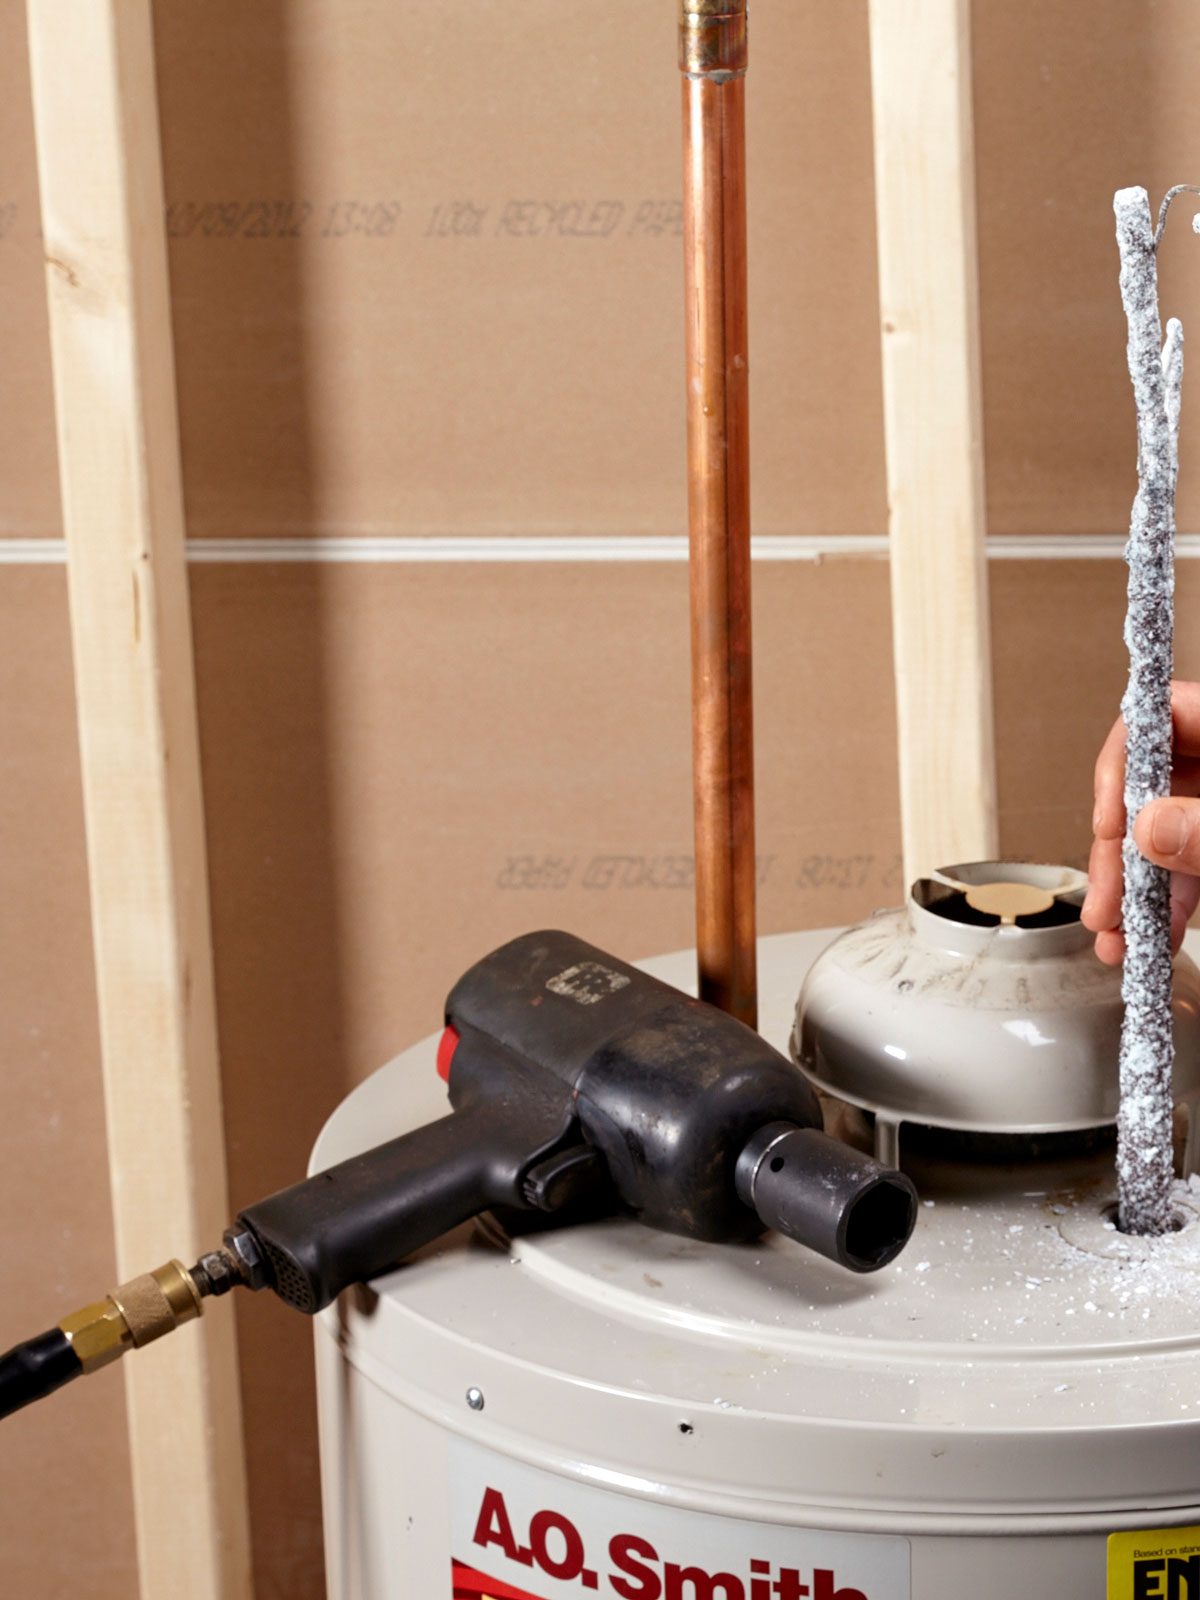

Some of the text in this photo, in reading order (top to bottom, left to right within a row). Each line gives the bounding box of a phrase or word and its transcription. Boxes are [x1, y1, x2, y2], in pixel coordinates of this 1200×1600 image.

[493, 200, 624, 237] RECYCLED
[627, 200, 683, 237] PAP
[472, 1486, 599, 1590] A.O.
[1133, 1549, 1163, 1559] Based
